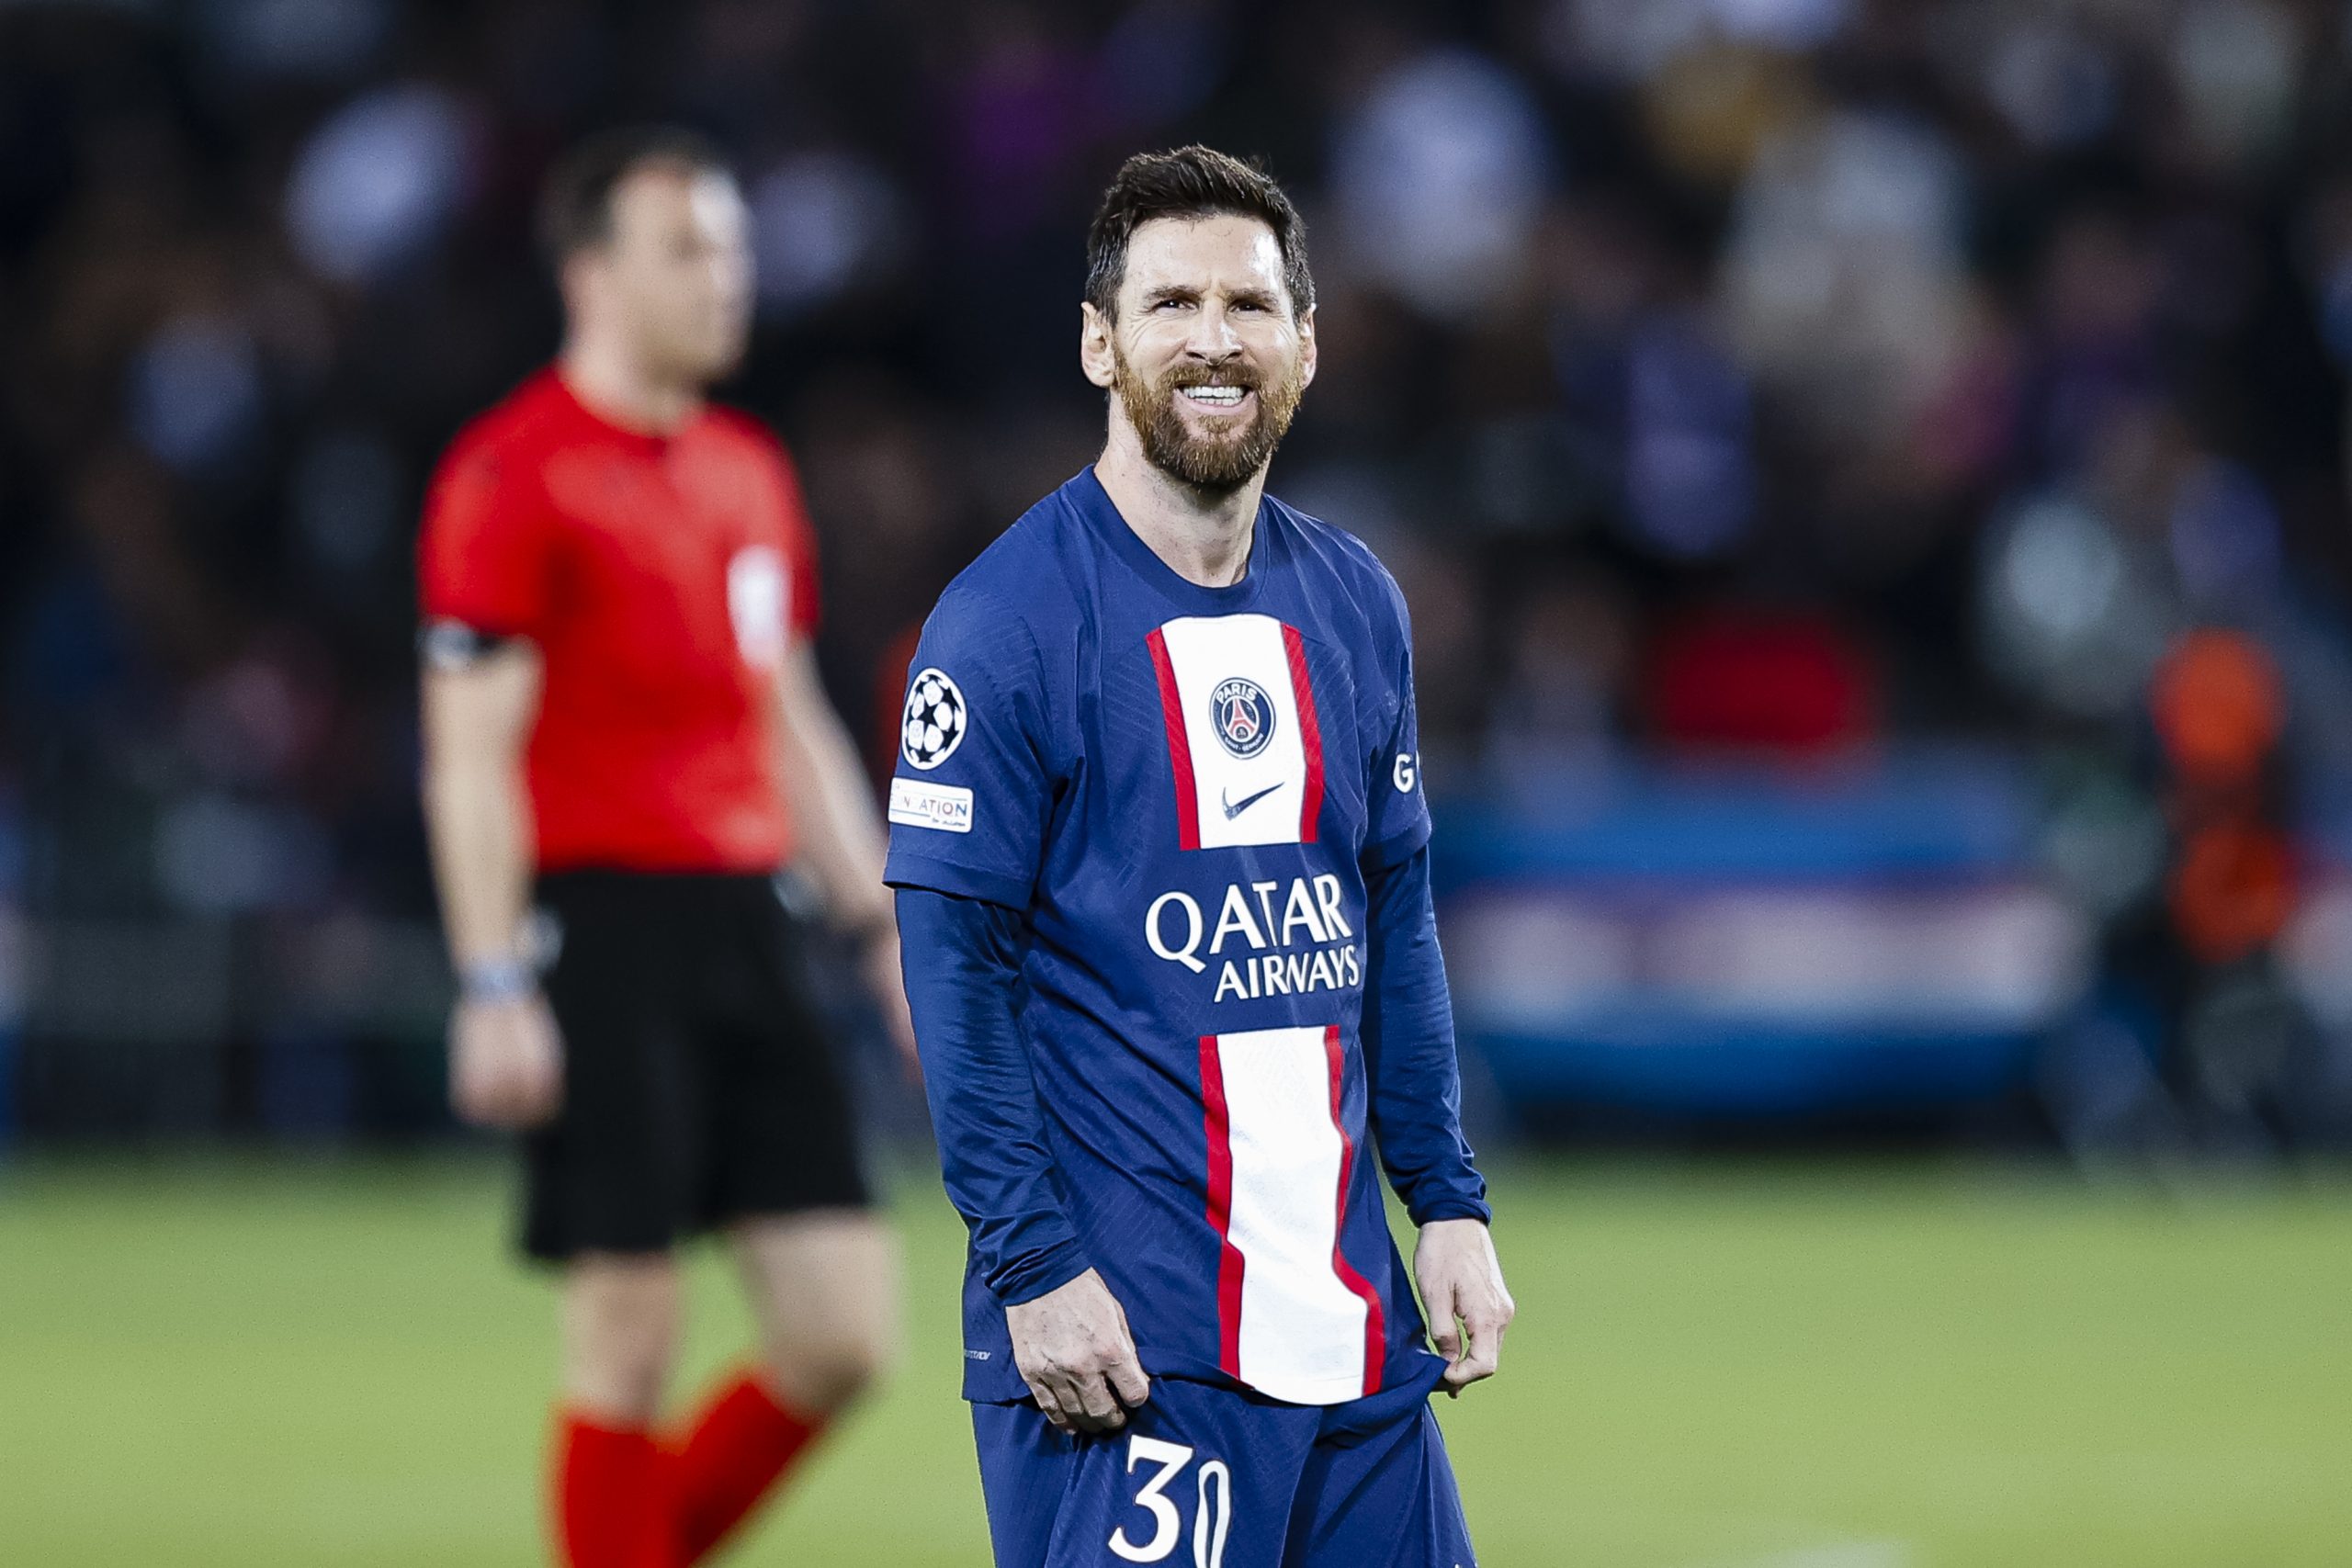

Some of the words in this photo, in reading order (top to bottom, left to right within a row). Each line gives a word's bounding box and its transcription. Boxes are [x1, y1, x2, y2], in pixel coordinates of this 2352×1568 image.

[1216, 682, 1258, 705] PARIS
[1393, 750, 1419, 794] G
[1145, 874, 1353, 975] QATAR
[1214, 944, 1360, 1003] AIRWAYS
[1108, 1434, 1231, 1568] 30
